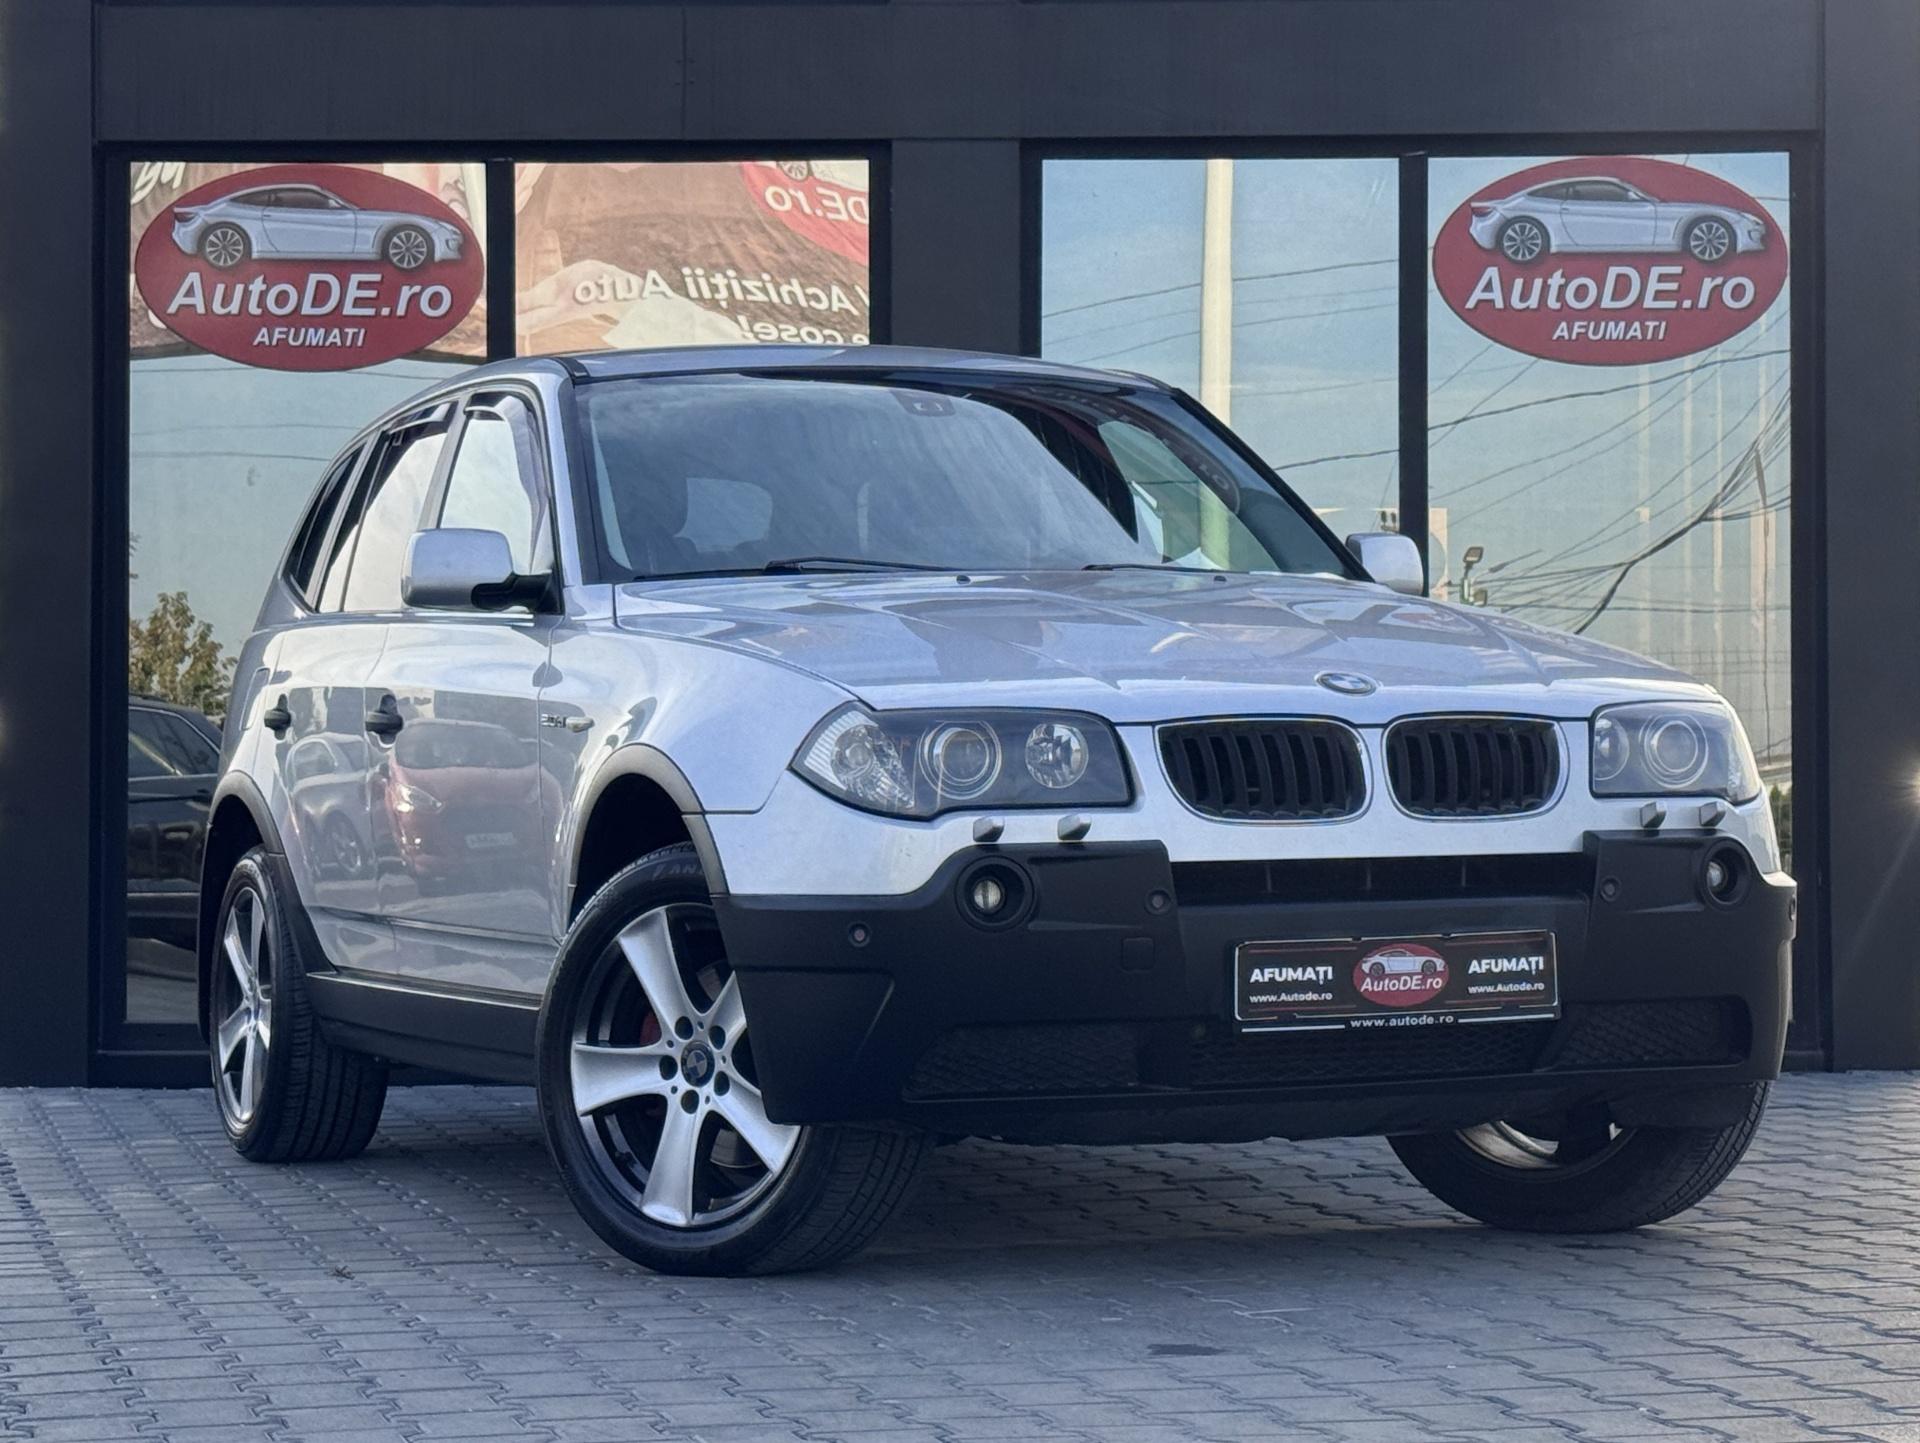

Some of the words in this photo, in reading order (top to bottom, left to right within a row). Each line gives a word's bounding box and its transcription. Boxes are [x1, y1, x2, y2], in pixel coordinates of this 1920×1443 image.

[166, 271, 452, 317] AutoDE.ro
[1465, 265, 1756, 310] AutoDE.ro
[252, 327, 366, 347] AFUMATI
[1552, 321, 1667, 341] AFUMATI
[1360, 975, 1443, 992] AutoDE.ro
[1468, 981, 1545, 994] www.Autode.ro
[1249, 991, 1333, 1003] www.Autode.ro
[1350, 1014, 1454, 1028] www.autode.ro
